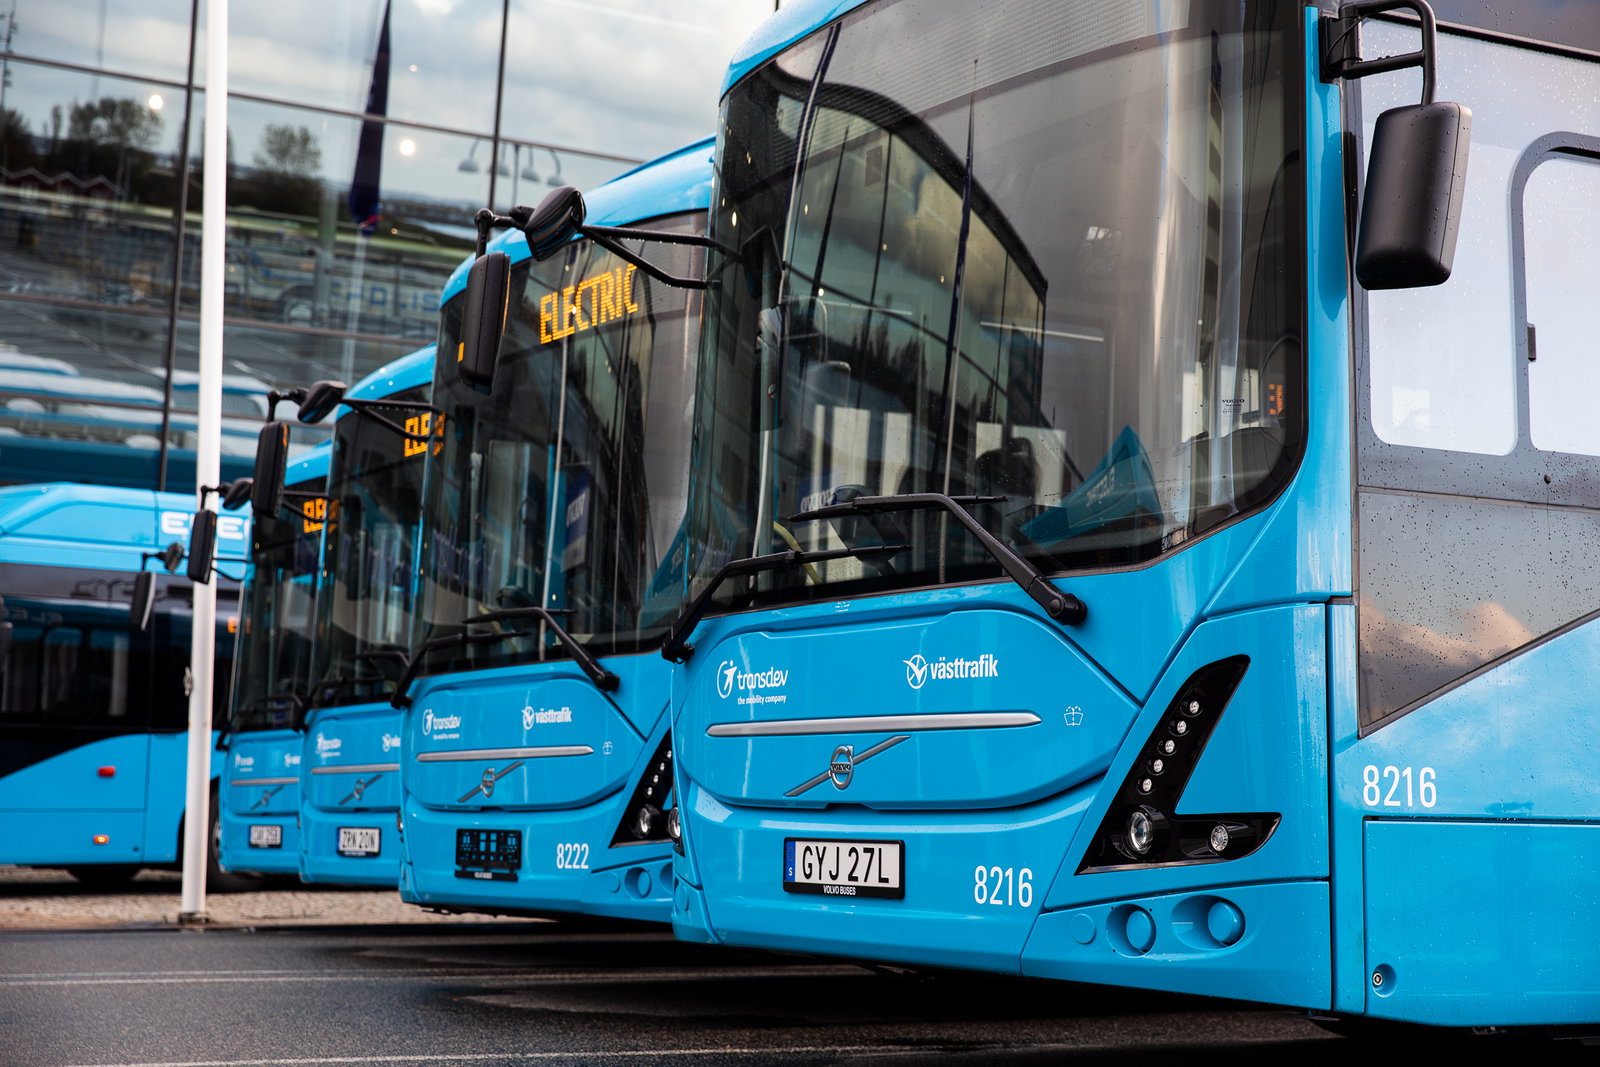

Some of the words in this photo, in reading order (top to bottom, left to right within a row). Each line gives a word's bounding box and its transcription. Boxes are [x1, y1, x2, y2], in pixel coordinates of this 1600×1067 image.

[540, 263, 638, 344] ELECTRIC
[737, 666, 789, 690] transdev
[930, 654, 999, 680] västtrafik
[737, 696, 745, 705] the
[746, 694, 764, 705] mobility
[765, 695, 786, 704] company
[1363, 764, 1437, 808] 8216
[556, 843, 589, 869] 8222
[788, 867, 793, 876] S
[802, 845, 840, 881] GYJ
[847, 847, 889, 883] 27L
[823, 885, 840, 895] VOLVO
[840, 886, 857, 896] BUSES
[974, 865, 1033, 907] 8216
